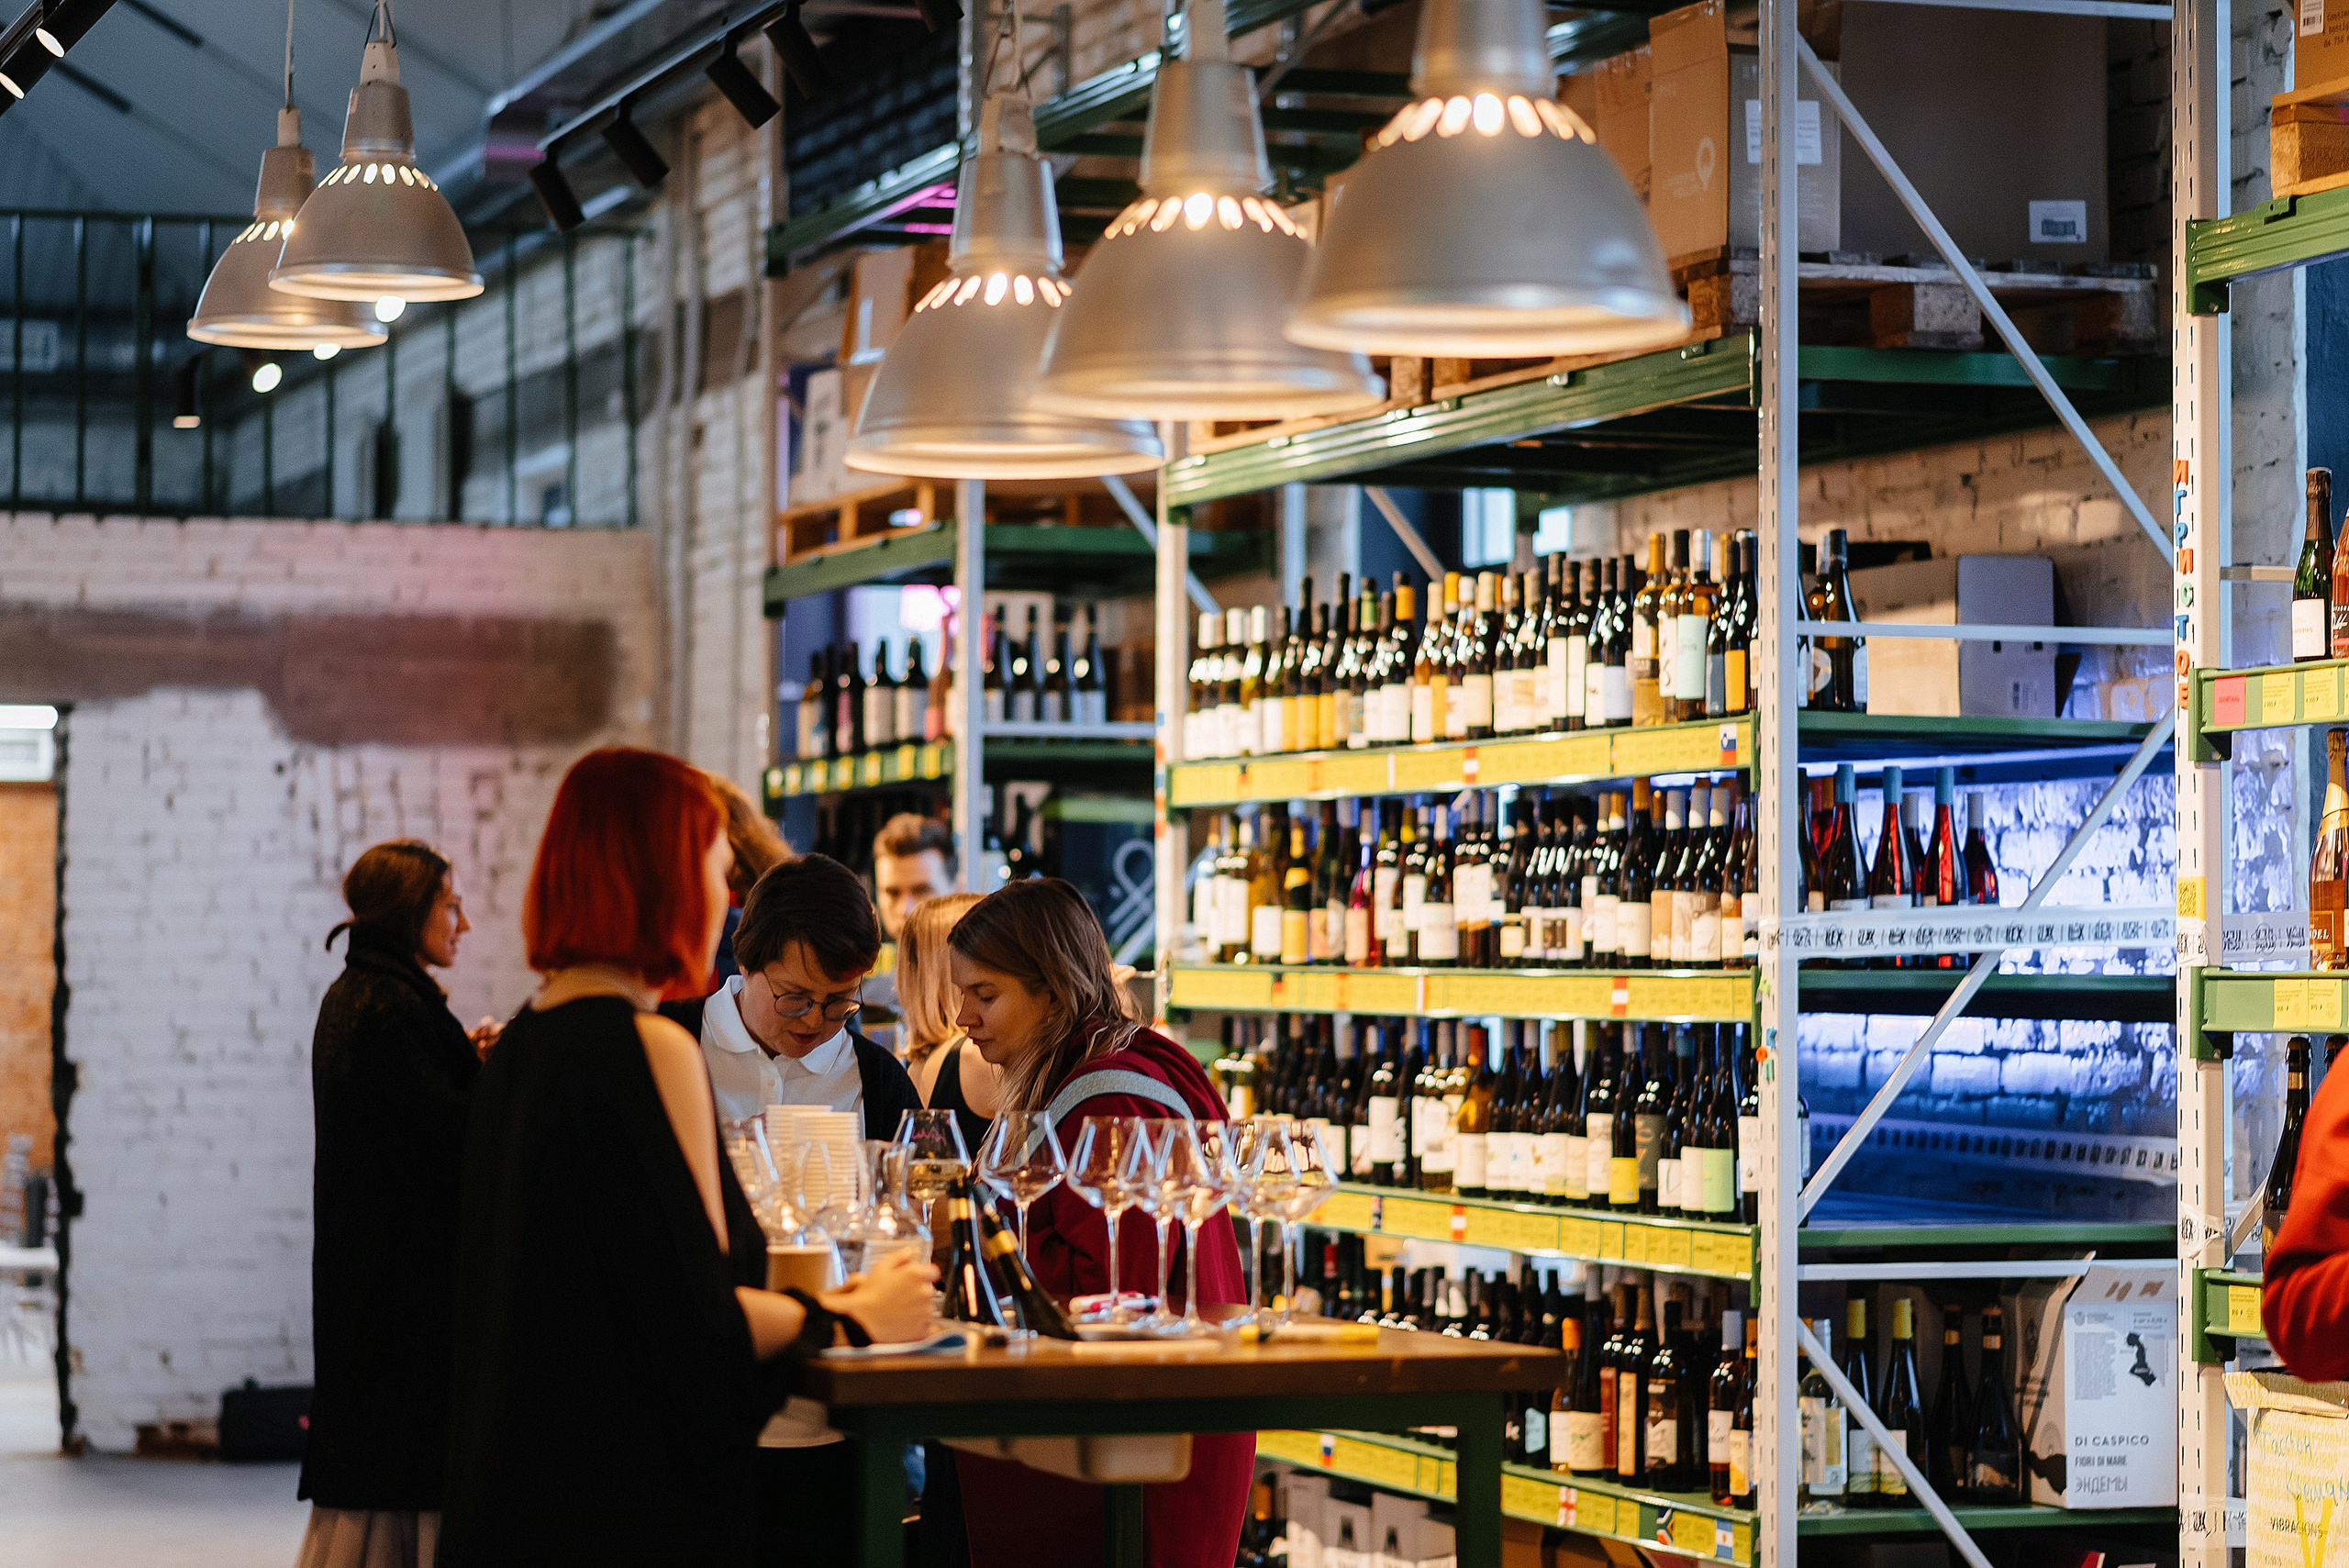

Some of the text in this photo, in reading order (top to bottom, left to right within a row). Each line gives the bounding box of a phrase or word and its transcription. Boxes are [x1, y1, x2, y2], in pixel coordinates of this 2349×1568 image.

[2172, 459, 2194, 709] ИГРИСТОЕ
[2075, 1435, 2150, 1447] DI CASPICO
[2075, 1454, 2127, 1467] FIORI DI MARE
[2075, 1475, 2128, 1496] ЭНДЕМЫ
[2270, 1516, 2324, 1540] VIBRACIONS
